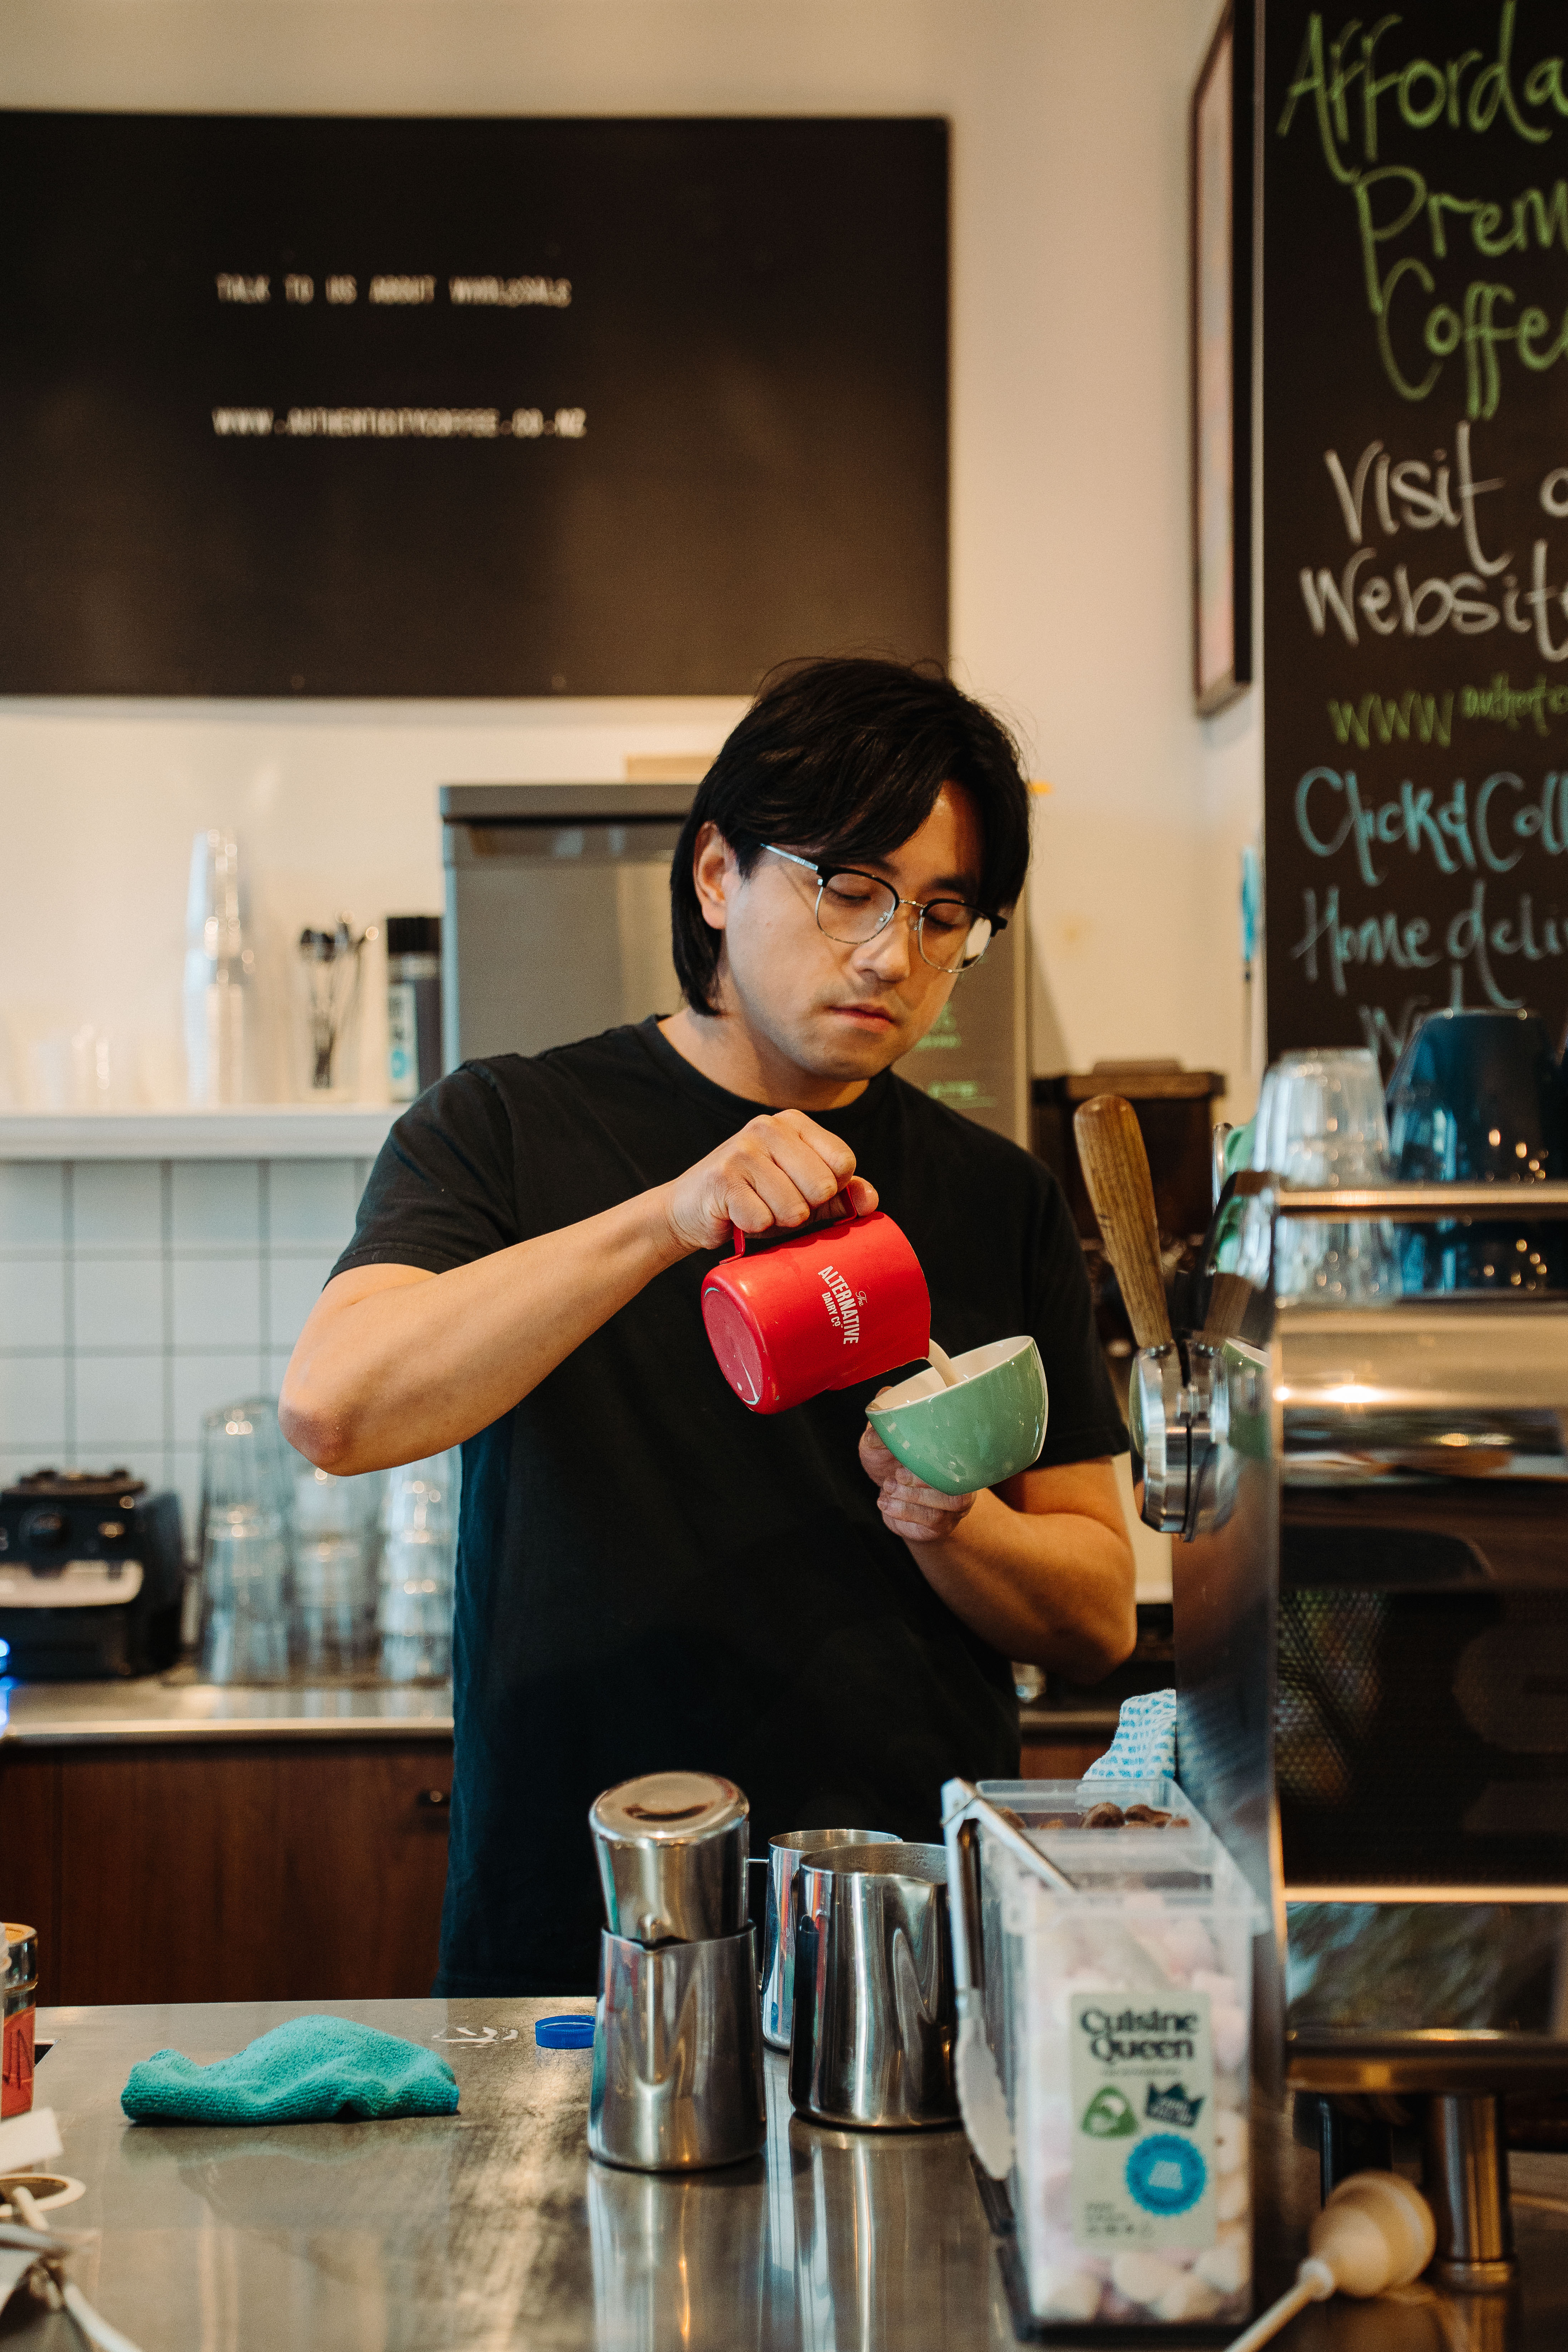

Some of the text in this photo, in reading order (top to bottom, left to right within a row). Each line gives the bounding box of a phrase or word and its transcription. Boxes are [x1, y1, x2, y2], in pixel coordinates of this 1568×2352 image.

[216, 274, 271, 304] TALK
[285, 274, 314, 304] TO
[325, 274, 357, 304] US
[368, 274, 437, 304] ABOUT
[1324, 420, 1513, 576] Visit
[1299, 548, 1568, 662] Websit
[817, 1266, 860, 1344] ALTERNATIVE
[822, 1292, 838, 1315] DAIRY
[855, 1291, 867, 1307] The
[1091, 2037, 1195, 2064] Queen
